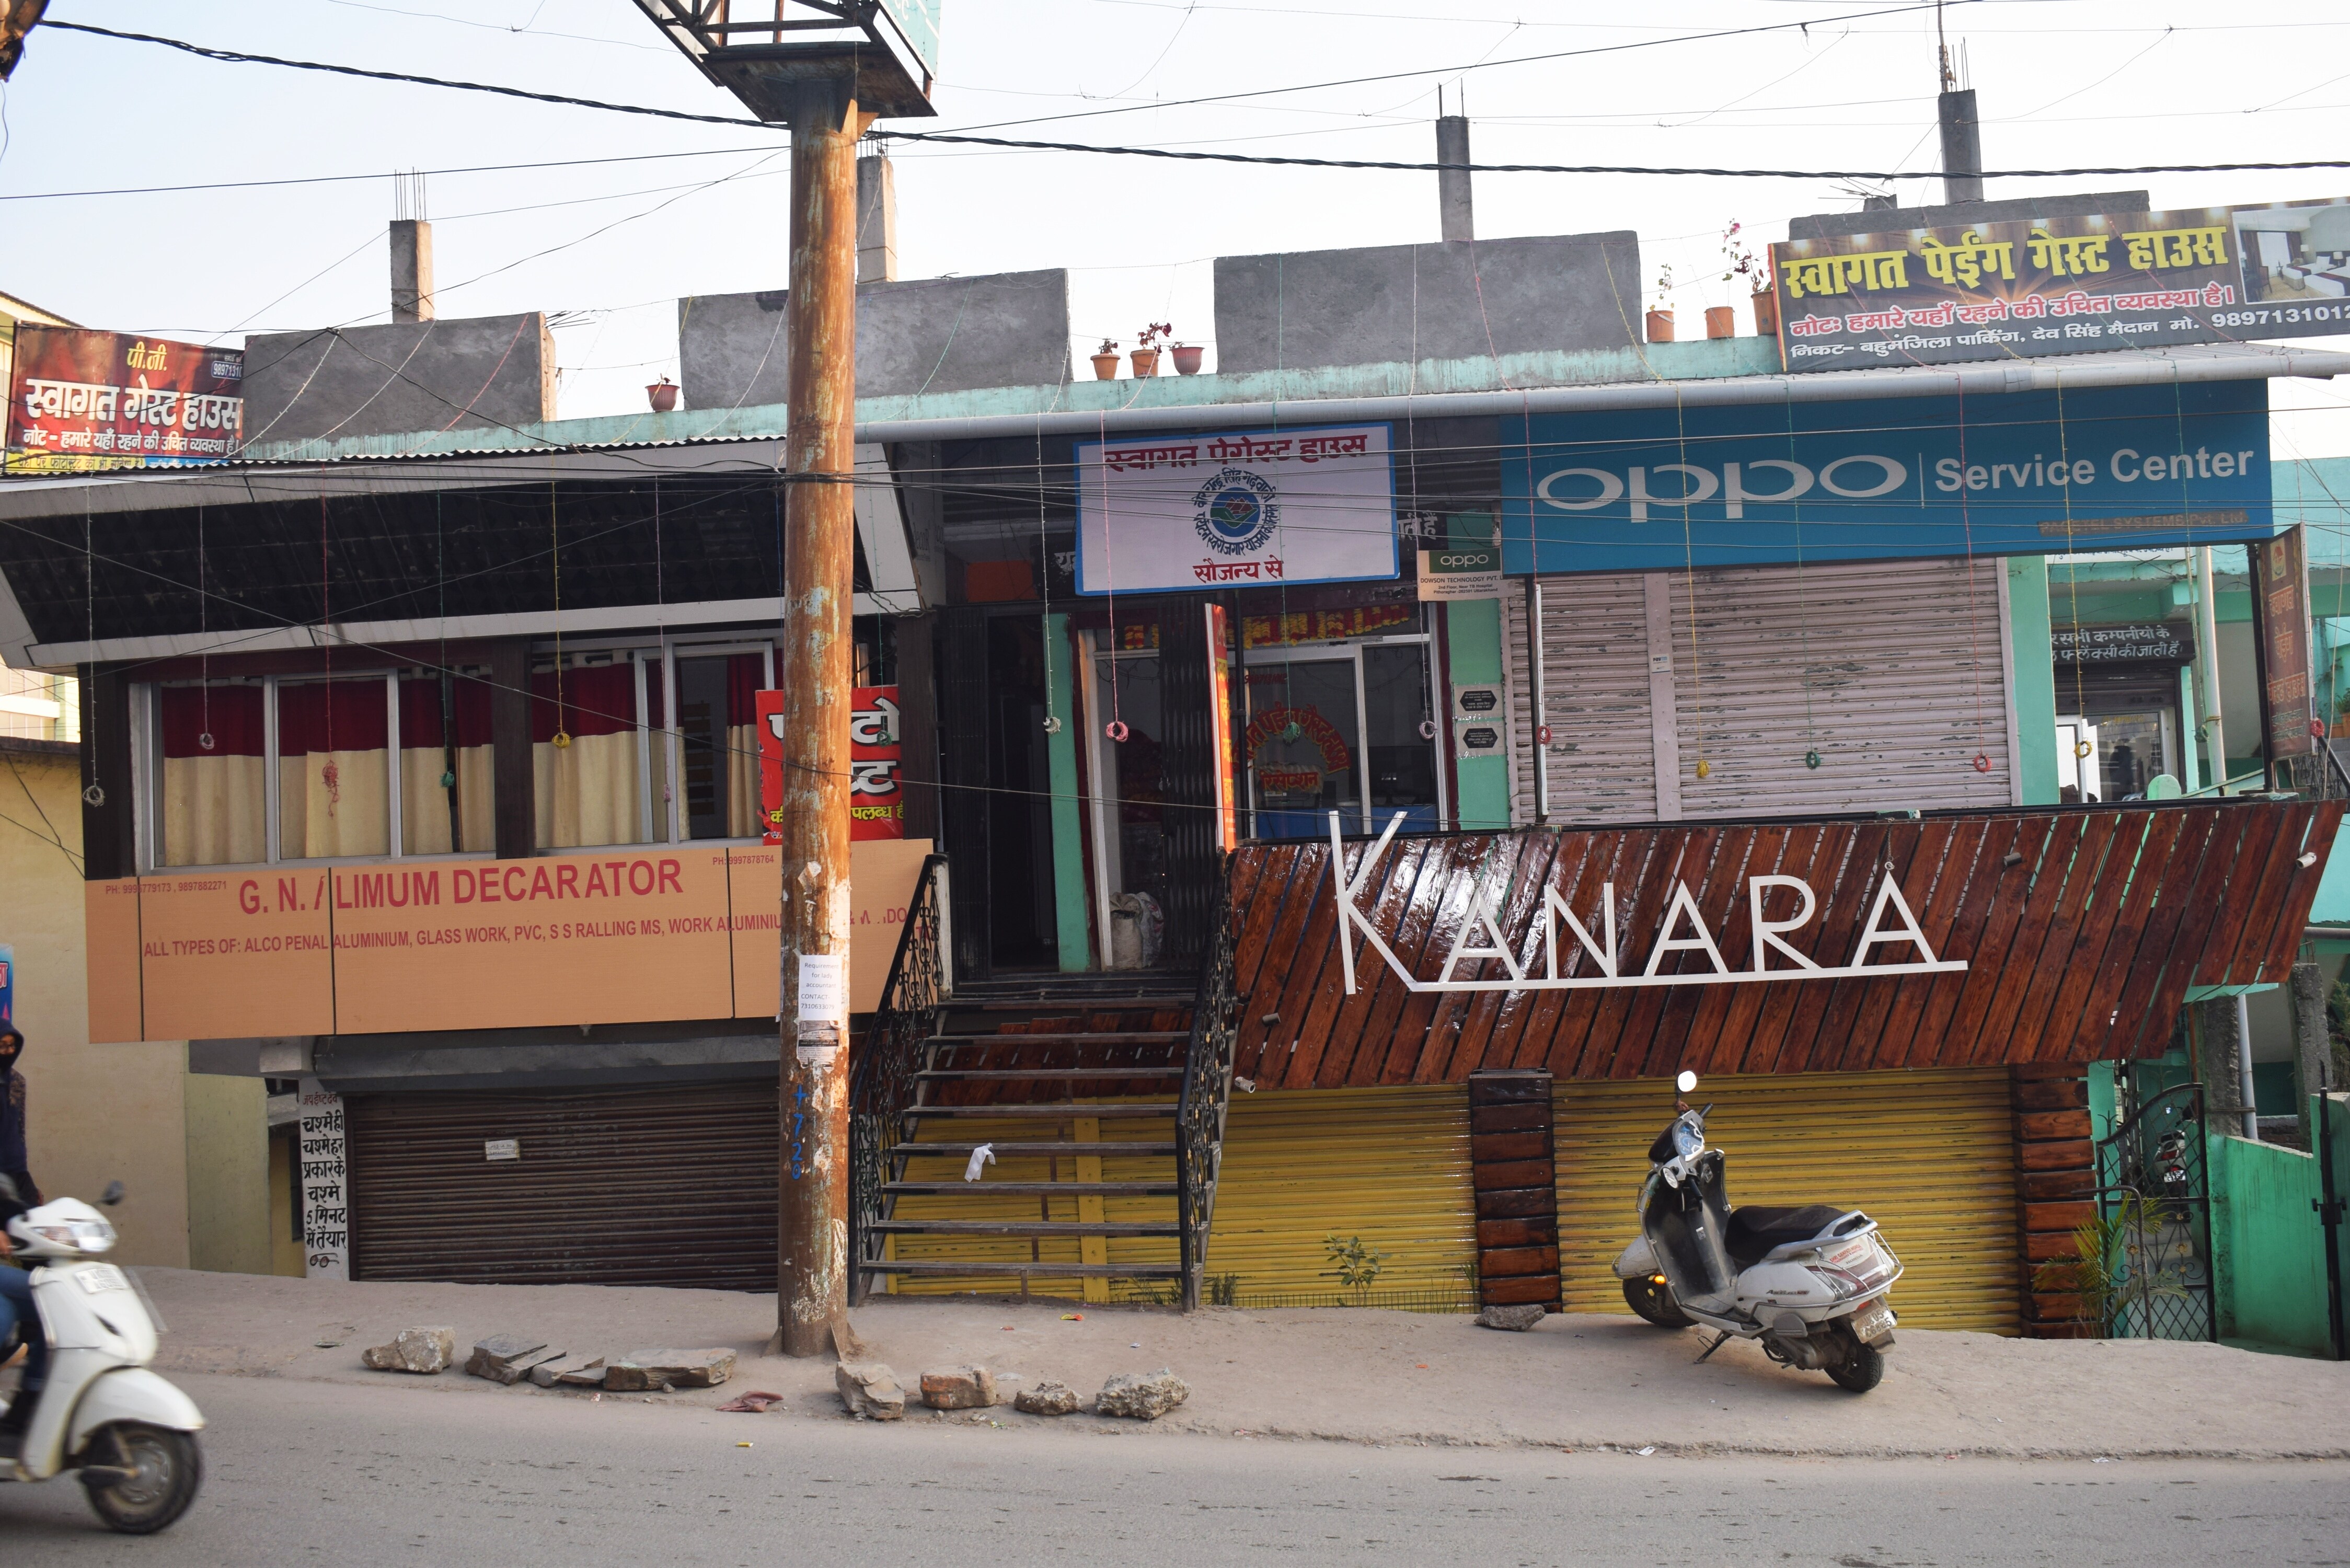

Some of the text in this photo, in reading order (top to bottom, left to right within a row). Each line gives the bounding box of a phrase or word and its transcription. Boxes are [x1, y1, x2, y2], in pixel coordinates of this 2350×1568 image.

[1780, 250, 1909, 299] स्वागत
[2026, 227, 2110, 276] गेस्ट
[2121, 226, 2229, 270] हाउस
[1845, 305, 1907, 334] हमारे
[1908, 300, 1956, 328] यहाँ
[1956, 297, 2010, 325] रहने
[2010, 294, 2047, 318] की
[2048, 291, 2111, 317] उचित
[2114, 288, 2199, 311] व्यवस्था
[1859, 333, 1951, 357] बहुमंजिला
[2031, 326, 2059, 340] देव
[2064, 322, 2101, 339] सिंह
[2107, 319, 2159, 335] मैदान
[26, 374, 244, 431] स्वागत गेस्ट हाउस
[23, 424, 48, 446] नोट
[60, 426, 91, 448] हमारे
[93, 428, 116, 450] यहाँ
[117, 429, 142, 452] रहने
[144, 430, 159, 449] की
[161, 431, 187, 452] उचित
[189, 437, 226, 453] व्यवस्था
[1105, 445, 1198, 472] स्वागत
[1299, 434, 1367, 463] हाउस
[1222, 467, 1242, 485] सिंह
[1935, 453, 2095, 493] Service
[2111, 446, 2254, 484] Center
[1193, 555, 1283, 584] सौजन्य से
[1440, 555, 1489, 568] oppo
[2156, 625, 2170, 639] के
[2137, 642, 2167, 657] जाती
[713, 855, 774, 865] PH: 9997878764
[106, 885, 120, 894] PH:
[178, 881, 227, 892] 9897882271
[239, 880, 269, 914] G.
[279, 877, 306, 912] N.
[453, 859, 684, 904] DECARATOR
[1329, 811, 1967, 995] KANARA
[144, 942, 169, 957] ALL
[172, 940, 215, 955] TYPES
[218, 938, 241, 953] OF:
[245, 936, 282, 952] ALCO
[285, 935, 329, 951] PENAL
[417, 928, 462, 945] GLASS
[465, 926, 511, 944] WORK,
[514, 925, 547, 941] PVC,
[576, 920, 637, 938] RALLING
[640, 919, 665, 937] MS,
[669, 917, 713, 934] WORK
[717, 913, 782, 931] ALUMINIU
[303, 1109, 343, 1133] चश्मे ही
[303, 1134, 343, 1156] चश्मे हर
[303, 1156, 345, 1179] प्रकार के
[307, 1180, 340, 1203] चश्मे
[307, 1204, 346, 1225] 5 मिनट
[306, 1225, 347, 1249] में तैयार
